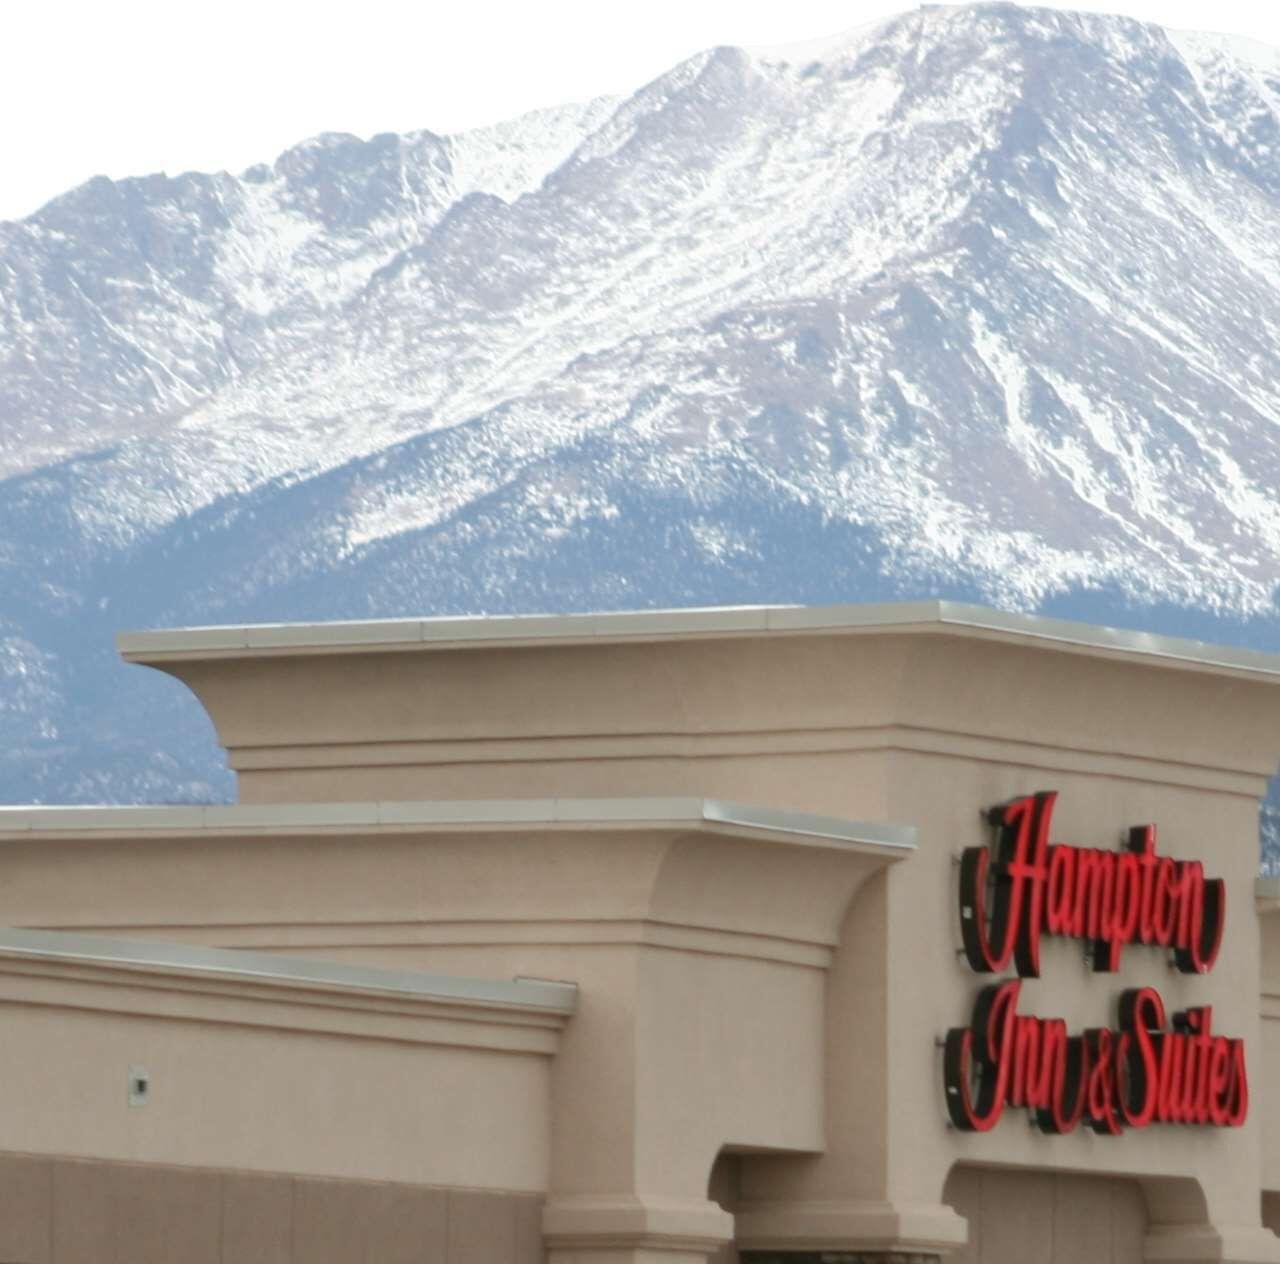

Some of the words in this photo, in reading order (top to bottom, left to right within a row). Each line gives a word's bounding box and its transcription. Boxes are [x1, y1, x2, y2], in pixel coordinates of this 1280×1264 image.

[963, 791, 1225, 975] Hampton
[948, 978, 1086, 1134] Inn
[1084, 1027, 1124, 1135] &
[1120, 986, 1249, 1128] Suites
